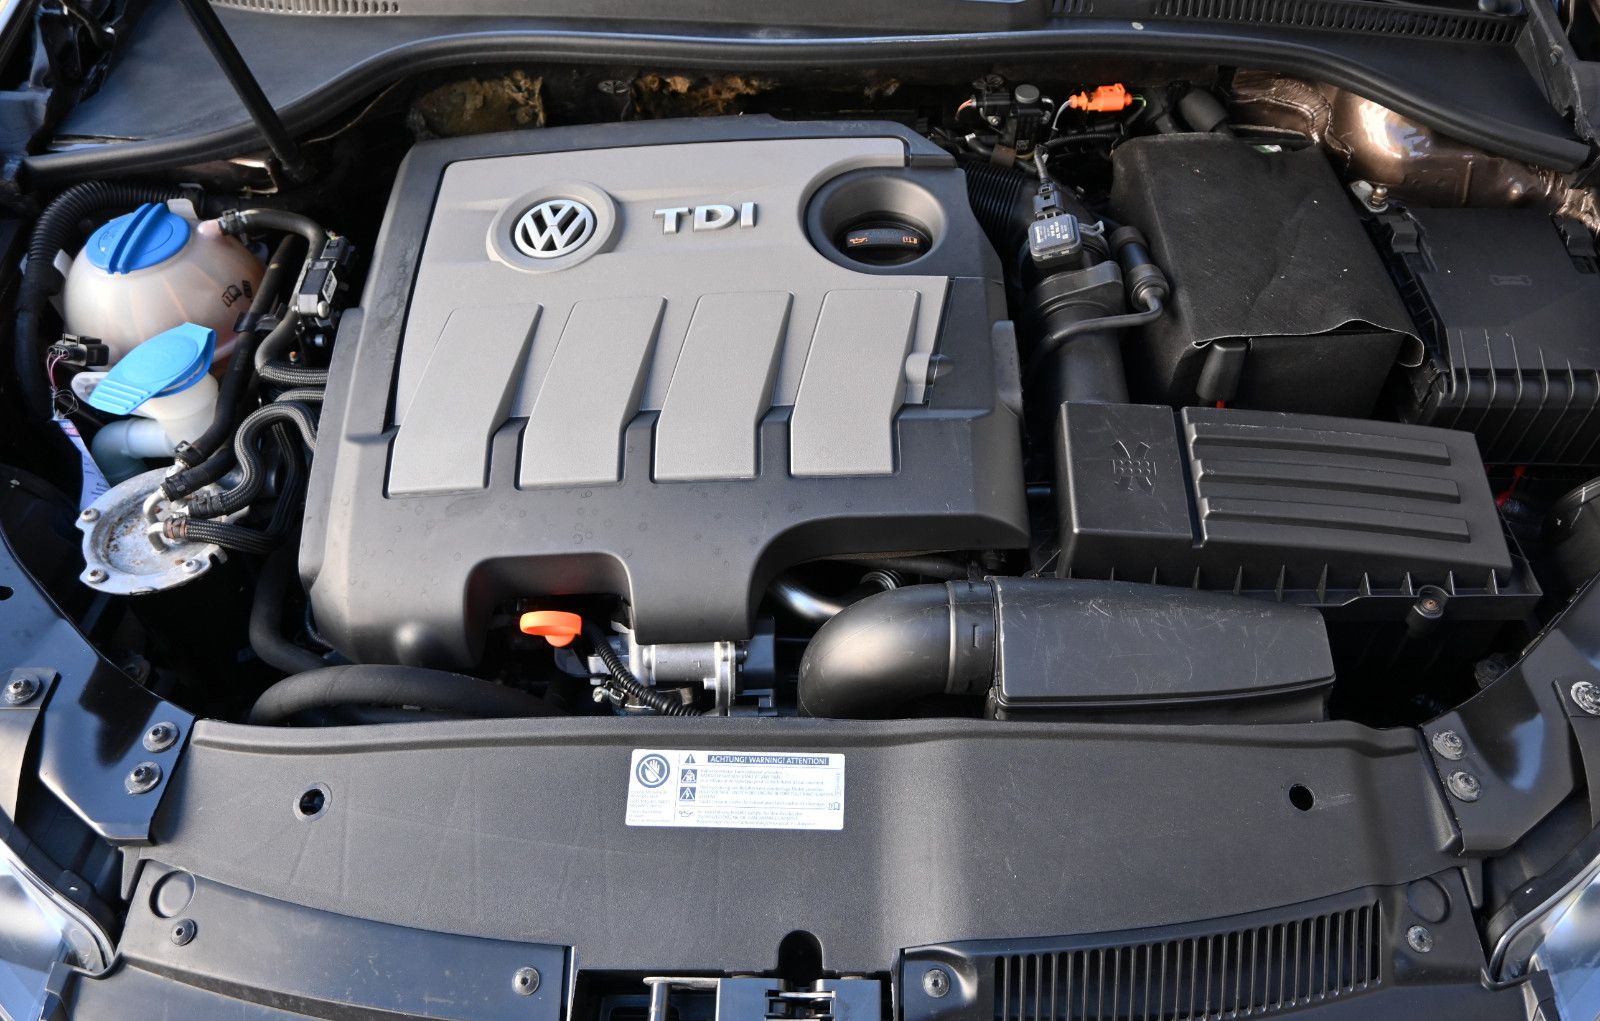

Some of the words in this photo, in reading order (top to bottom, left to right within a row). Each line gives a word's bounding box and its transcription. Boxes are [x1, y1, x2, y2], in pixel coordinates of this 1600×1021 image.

[653, 201, 759, 235] TDI
[710, 755, 747, 763] ACHTUNG!
[749, 756, 785, 764] WARNING!
[786, 757, 827, 765] ATTENTION!
